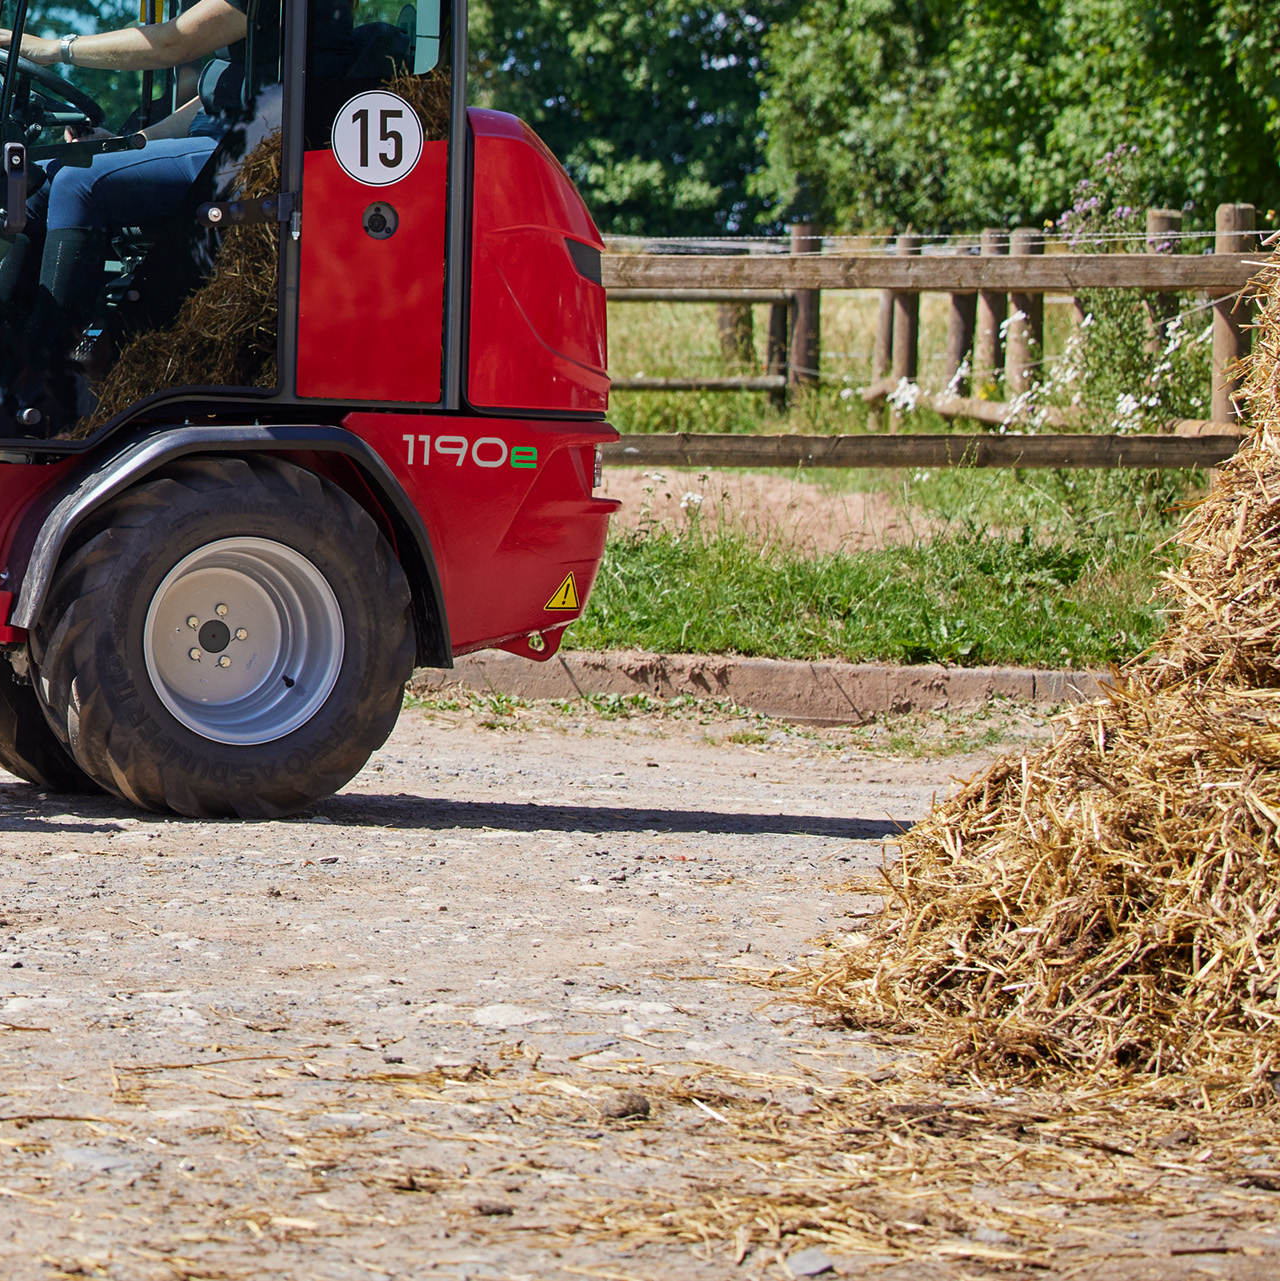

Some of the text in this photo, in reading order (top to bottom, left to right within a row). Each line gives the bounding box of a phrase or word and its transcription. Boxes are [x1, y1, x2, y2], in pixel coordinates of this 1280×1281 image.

[351, 109, 403, 168] 15
[402, 434, 538, 469] 1190e
[126, 704, 230, 784] DUMPER
